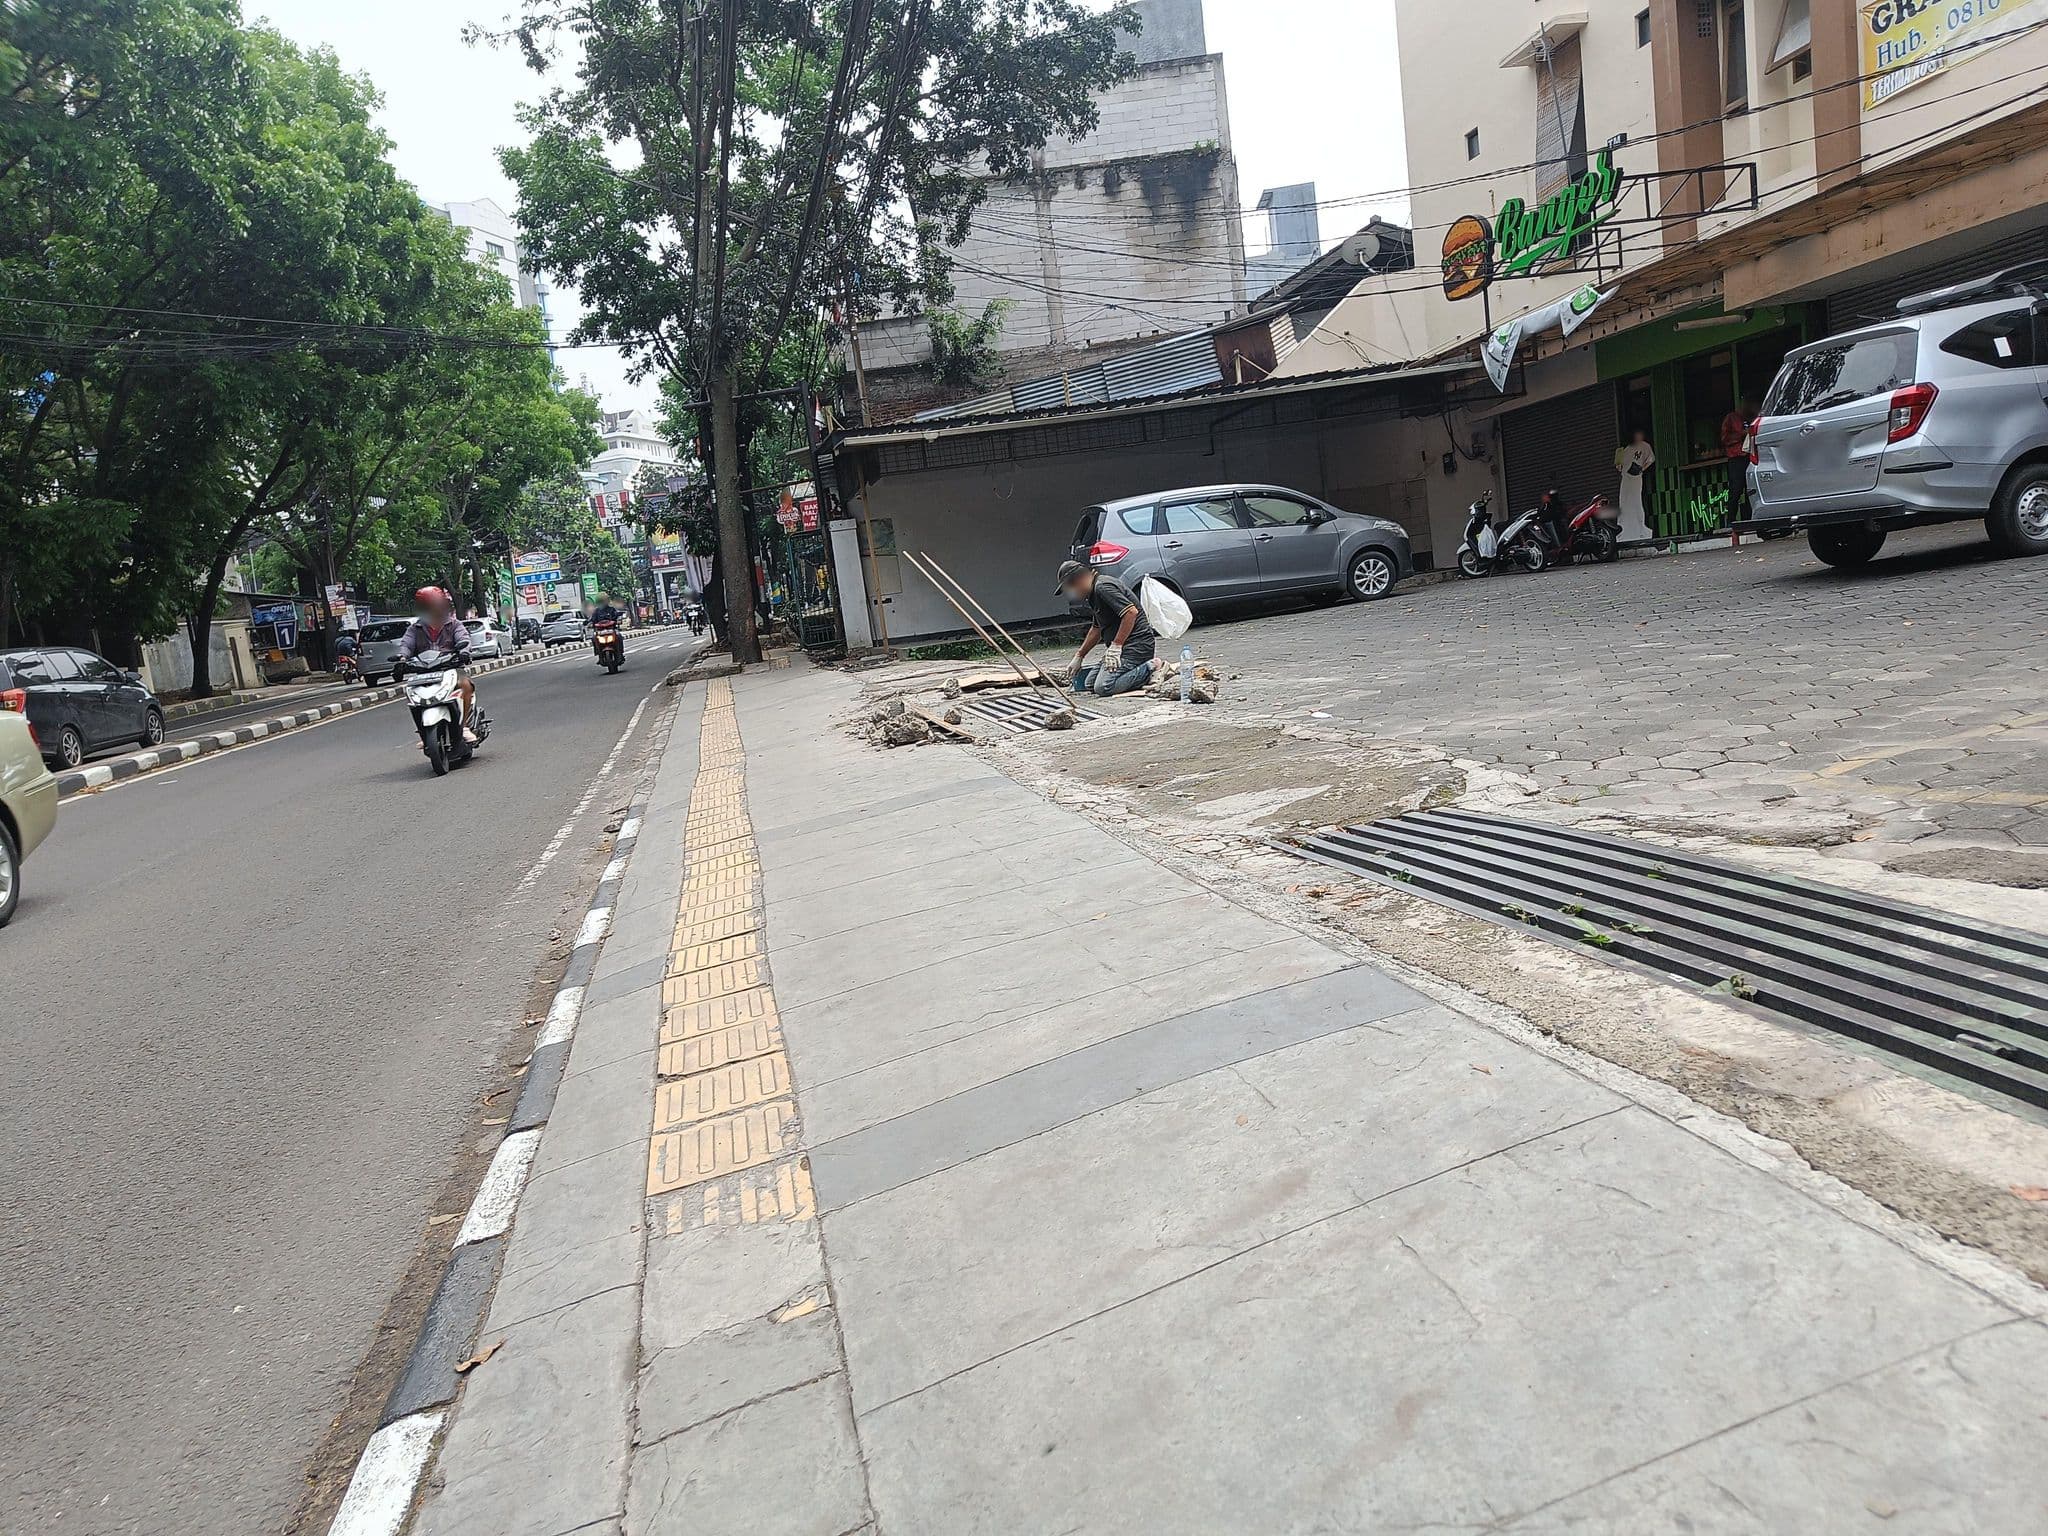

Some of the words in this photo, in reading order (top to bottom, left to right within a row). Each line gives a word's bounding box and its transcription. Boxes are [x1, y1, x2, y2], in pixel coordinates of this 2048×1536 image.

[1876, 28, 1927, 69] Hub.
[1607, 134, 1622, 149] TM
[281, 628, 290, 645] 1
